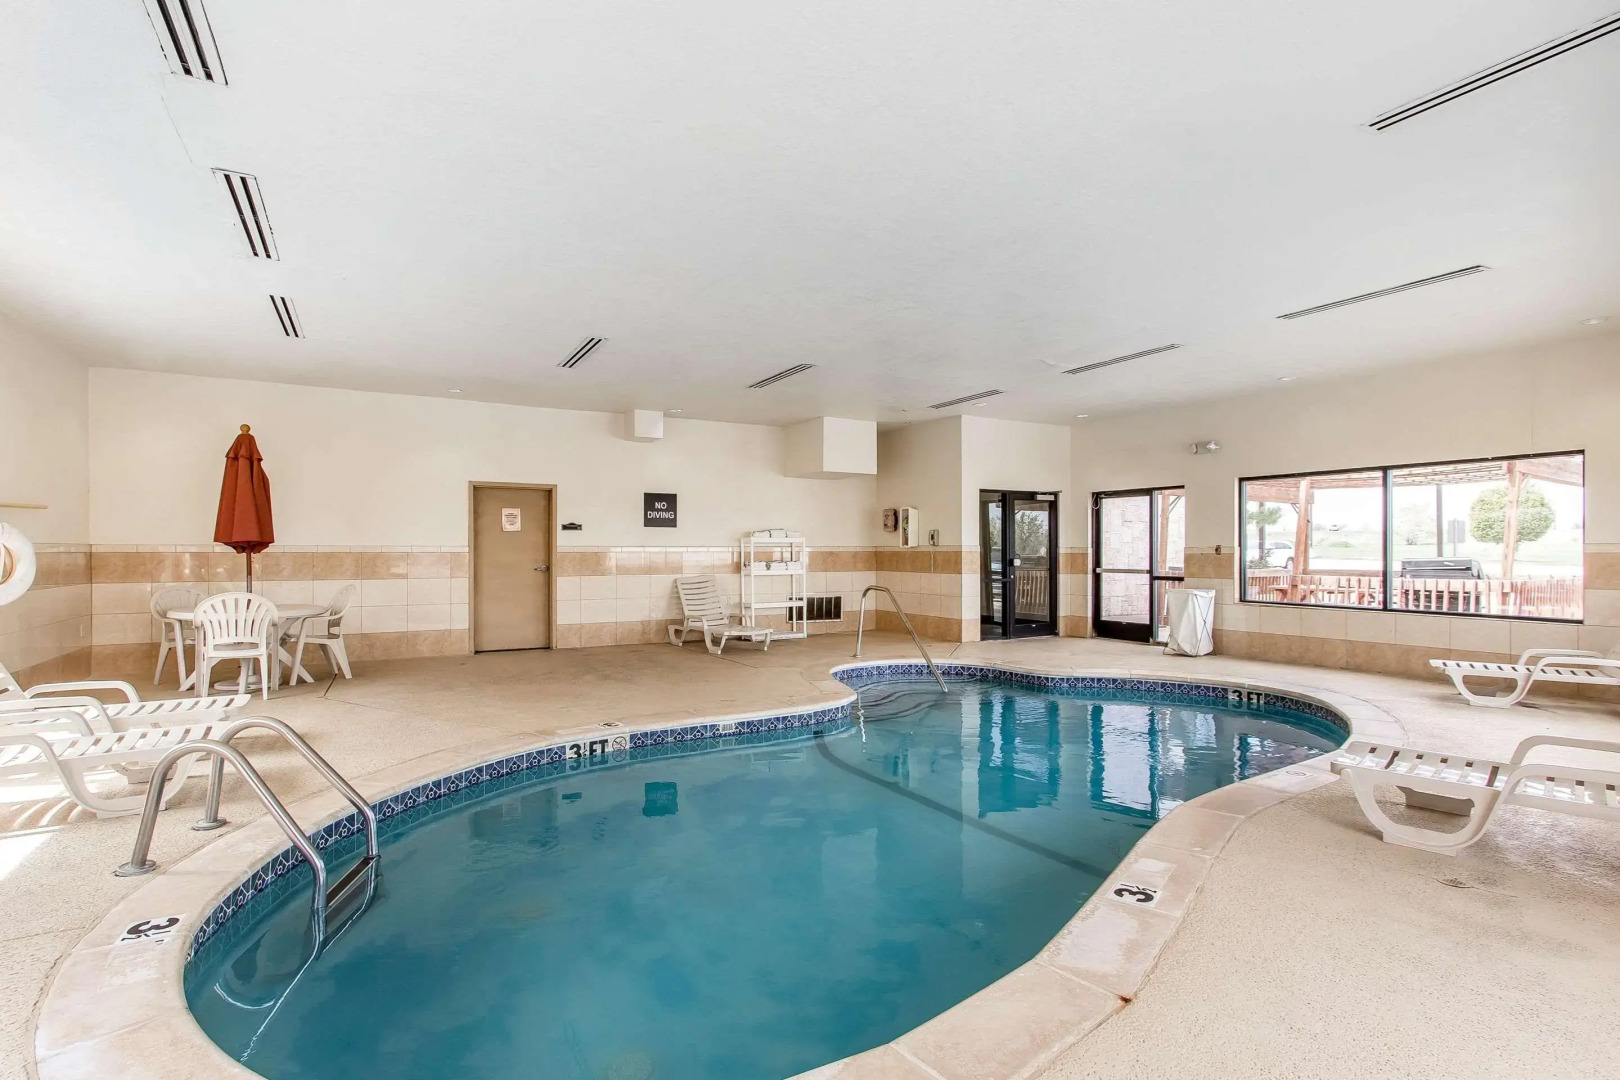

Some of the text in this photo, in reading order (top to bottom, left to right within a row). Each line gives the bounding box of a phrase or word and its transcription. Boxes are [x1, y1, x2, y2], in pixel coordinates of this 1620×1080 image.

[655, 501, 667, 509] NO
[647, 511, 675, 519] DIVING
[1231, 689, 1263, 703] 3 FT
[589, 739, 608, 755] FT
